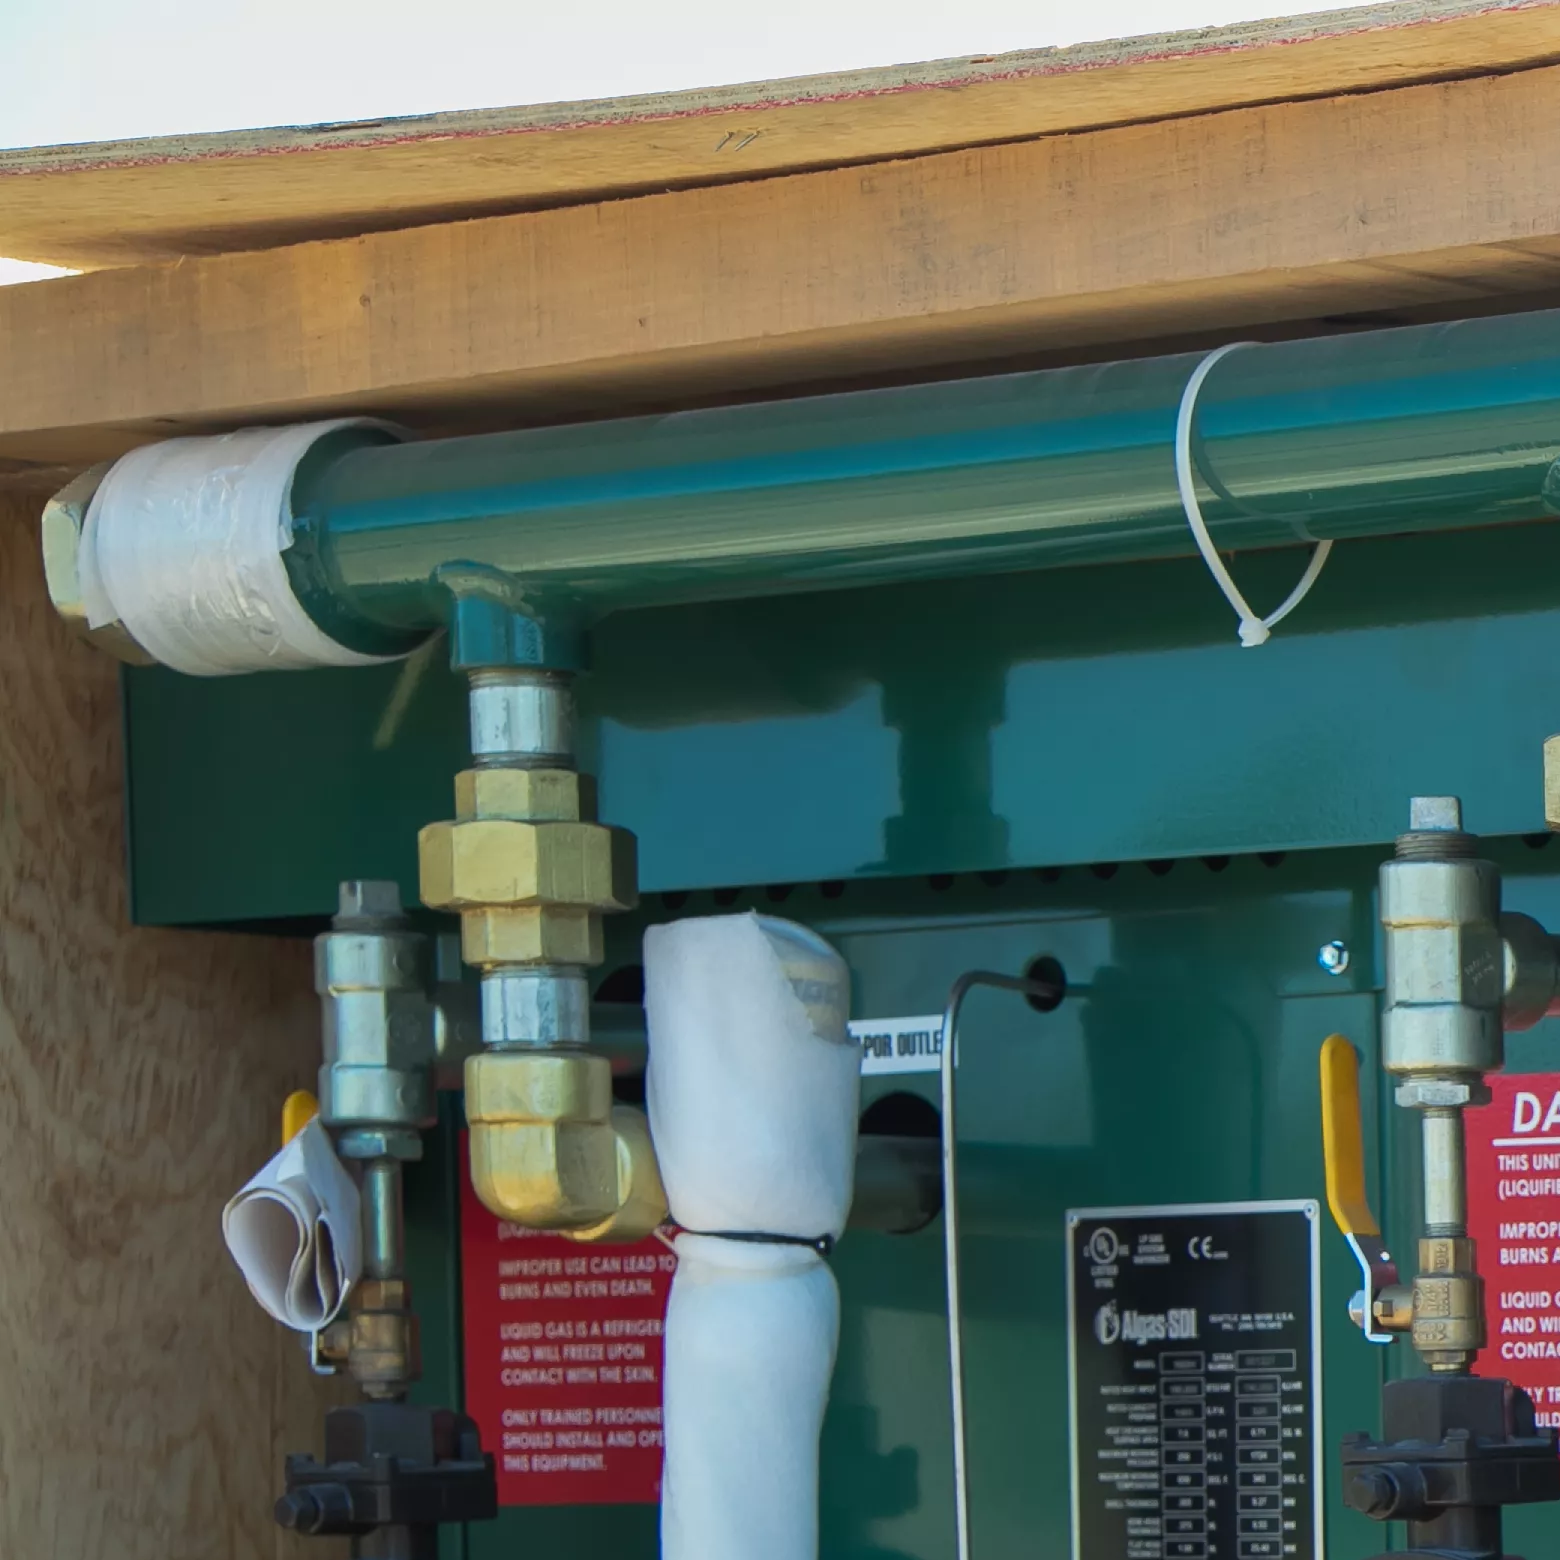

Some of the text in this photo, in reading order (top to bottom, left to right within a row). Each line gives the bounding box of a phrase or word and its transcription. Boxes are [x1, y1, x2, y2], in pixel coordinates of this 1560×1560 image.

[863, 1029, 942, 1058] POR OUTLE
[1498, 1154, 1529, 1171] THIS
[1500, 1247, 1549, 1265] BURNS
